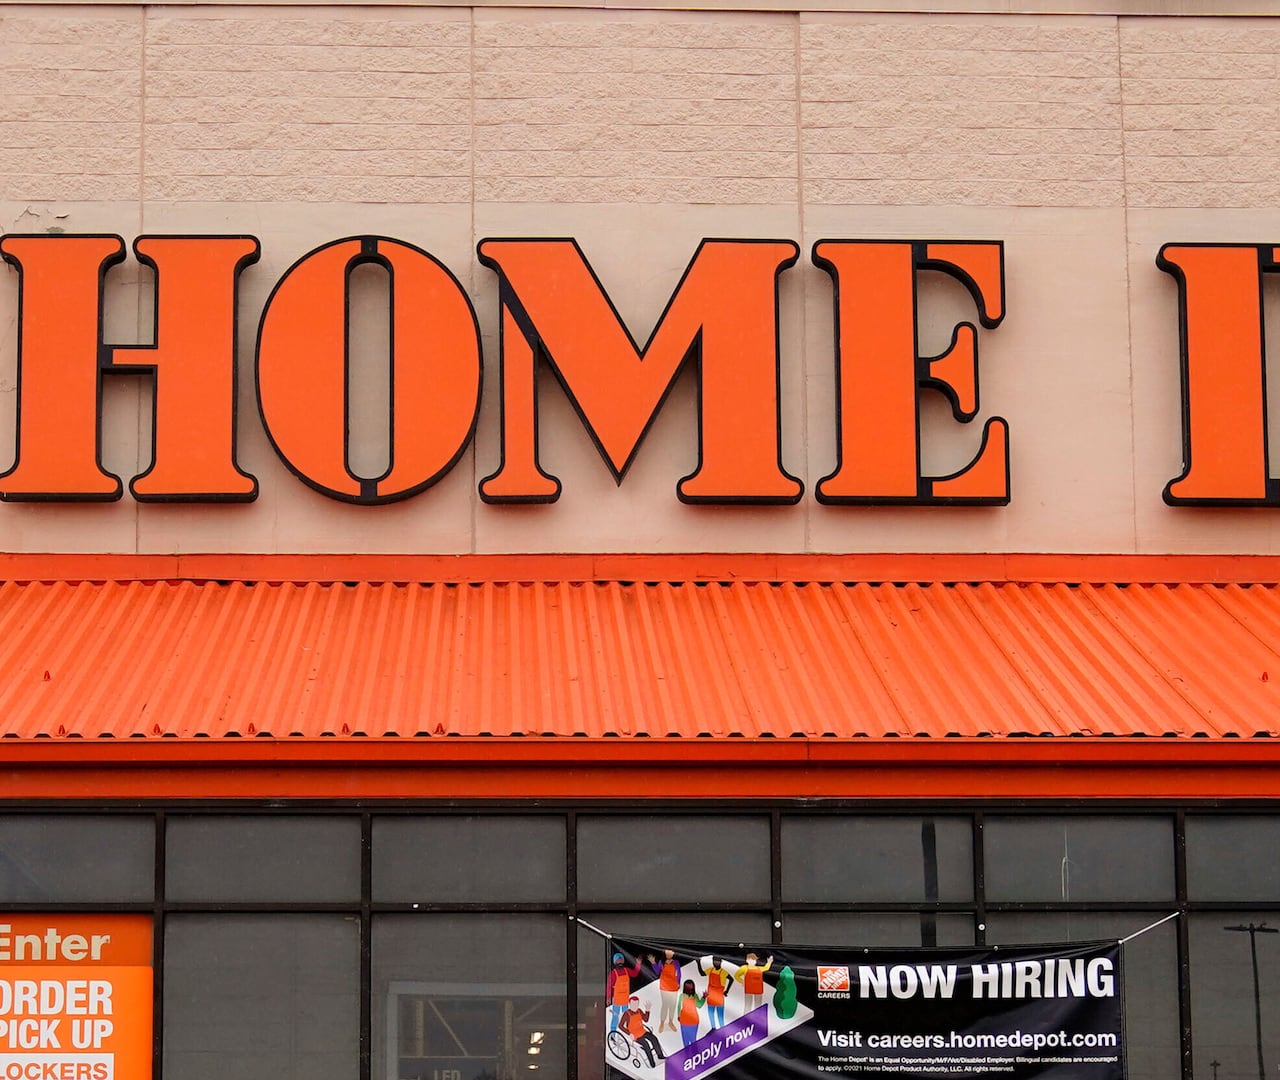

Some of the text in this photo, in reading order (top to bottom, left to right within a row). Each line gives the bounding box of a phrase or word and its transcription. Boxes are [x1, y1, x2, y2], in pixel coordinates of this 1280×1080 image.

[858, 957, 1114, 999] NOW HIRING
[71, 1019, 114, 1049] UP
[683, 1024, 755, 1071] apply now
[817, 1030, 1117, 1050] Visit careers.homedepot.com
[825, 1065, 842, 1073] apply.
[973, 1065, 988, 1073] rights
